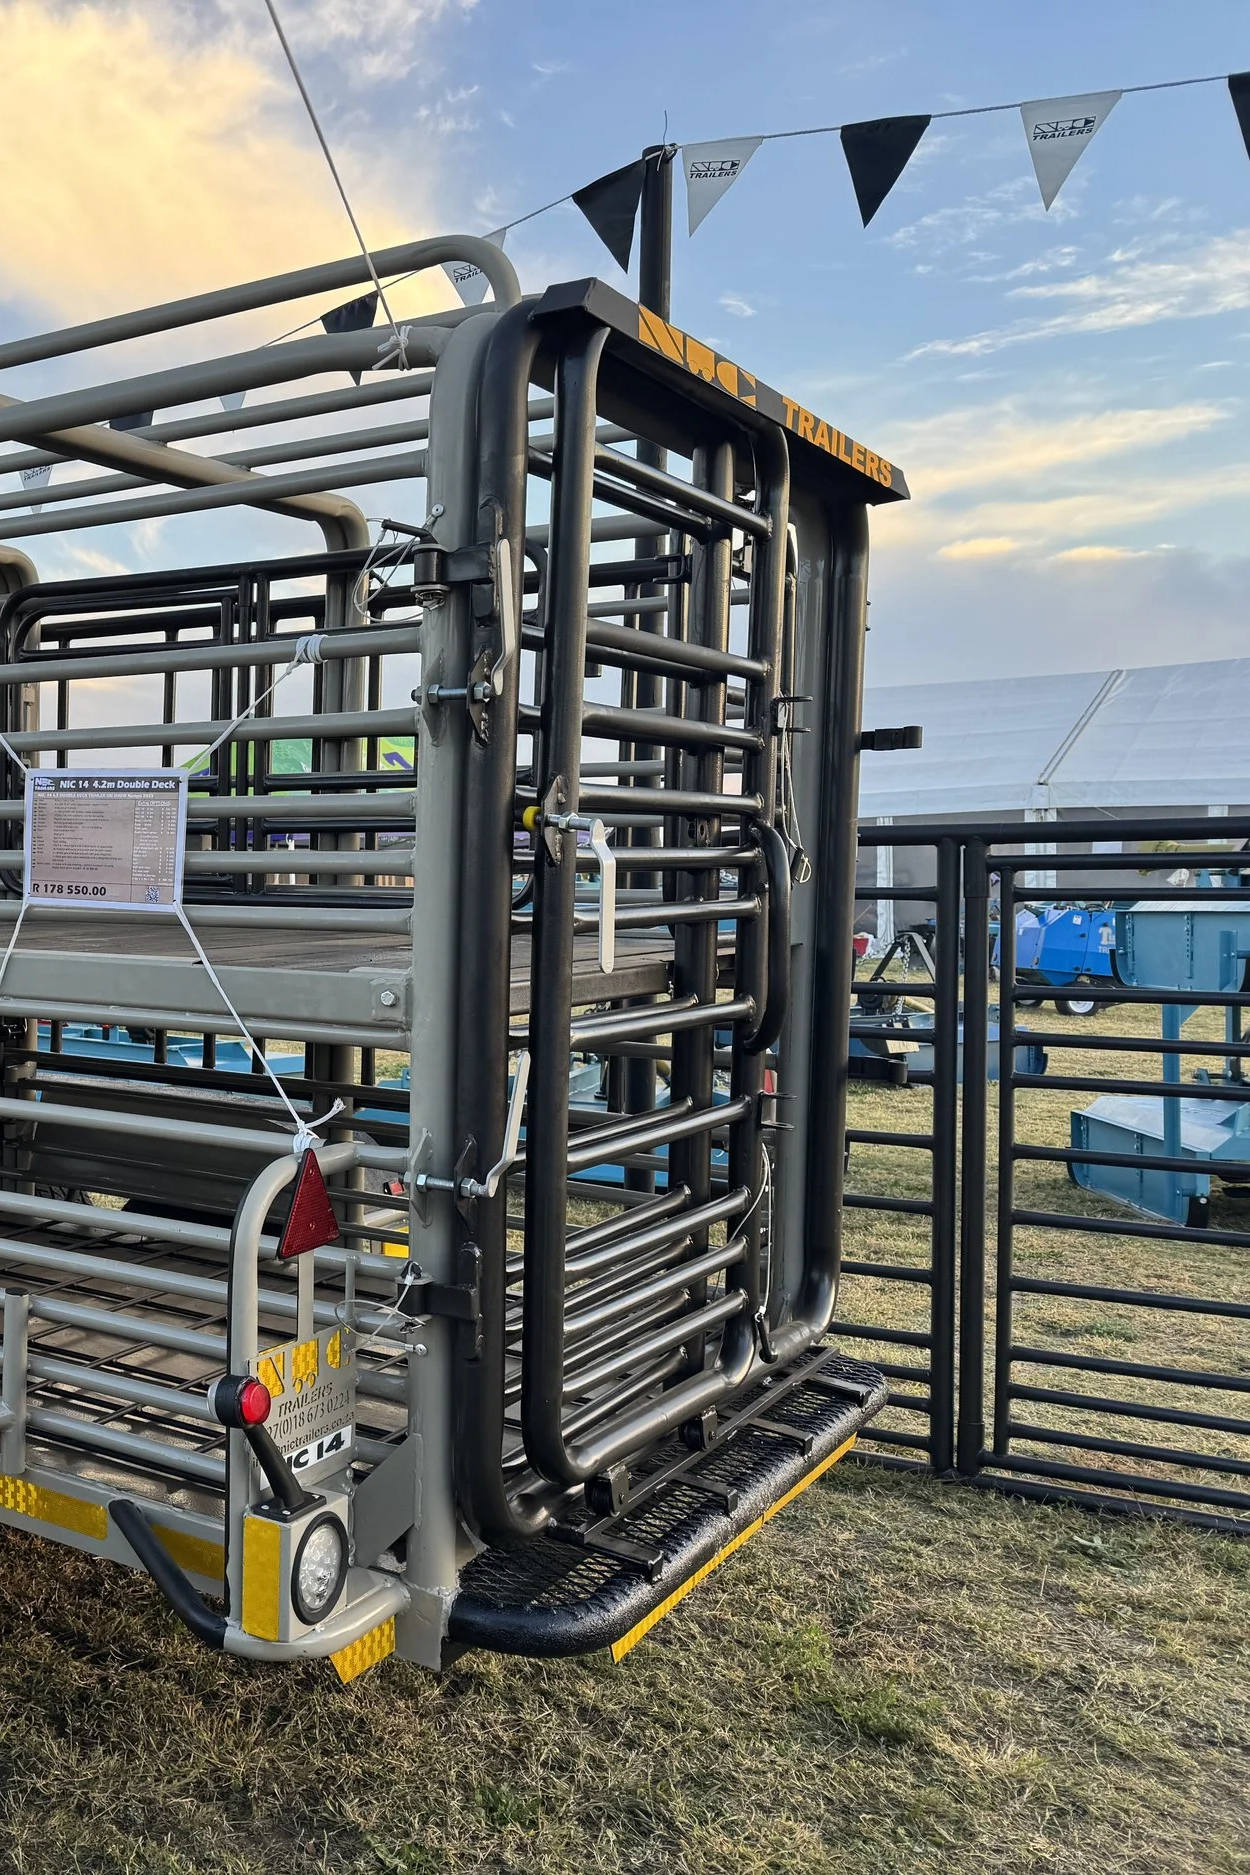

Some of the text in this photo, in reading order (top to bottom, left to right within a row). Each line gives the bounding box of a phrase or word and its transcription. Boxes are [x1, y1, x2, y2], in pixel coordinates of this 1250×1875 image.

[1032, 127, 1094, 141] TRAILERS
[689, 170, 738, 179] TRAILERS
[782, 396, 892, 488] TRAILERS
[59, 779, 175, 789] NIC 14 4.2m Double Deck
[32, 883, 107, 896] R 178 550.00
[278, 1382, 333, 1418] TRAILERS
[307, 1401, 325, 1423] 673
[327, 1389, 350, 1414] 0224
[283, 1431, 345, 1475] IC 14
